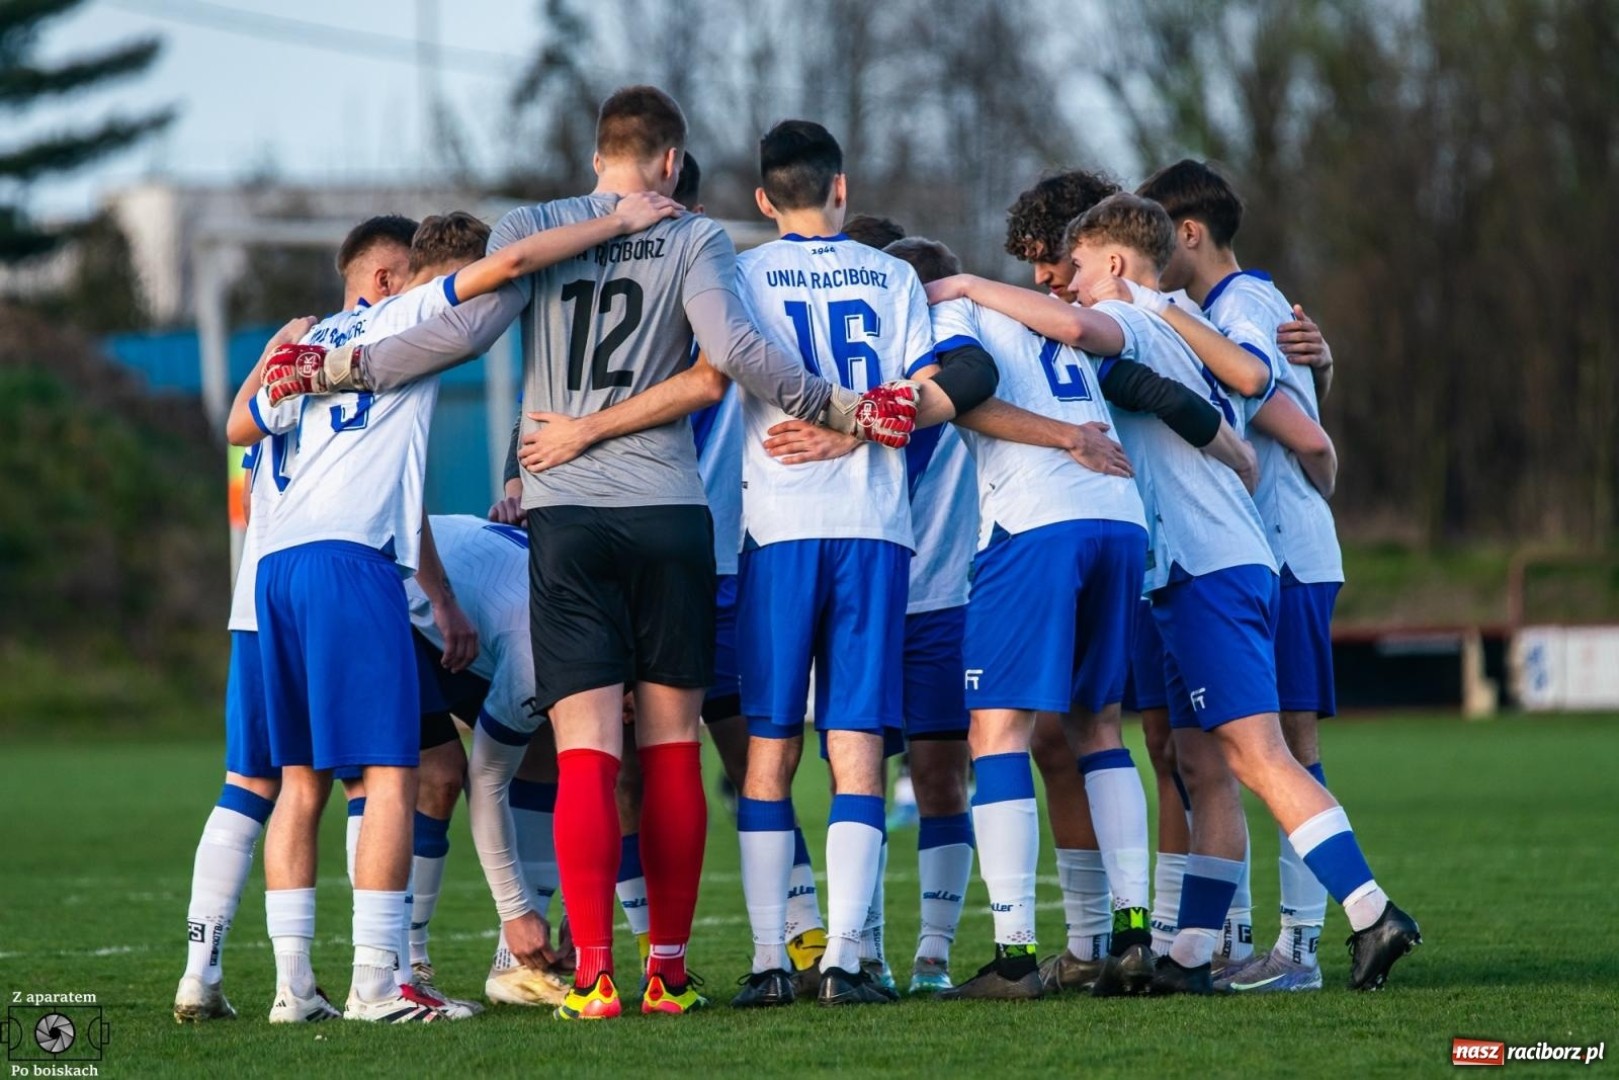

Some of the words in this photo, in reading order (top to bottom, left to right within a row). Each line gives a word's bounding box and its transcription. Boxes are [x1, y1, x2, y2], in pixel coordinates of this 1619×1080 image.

[595, 238, 665, 267] RCIBÓRZ
[766, 270, 808, 288] UNIA
[811, 266, 888, 290] RACIBÓRZ
[561, 277, 643, 391] 12
[784, 298, 881, 394] 16
